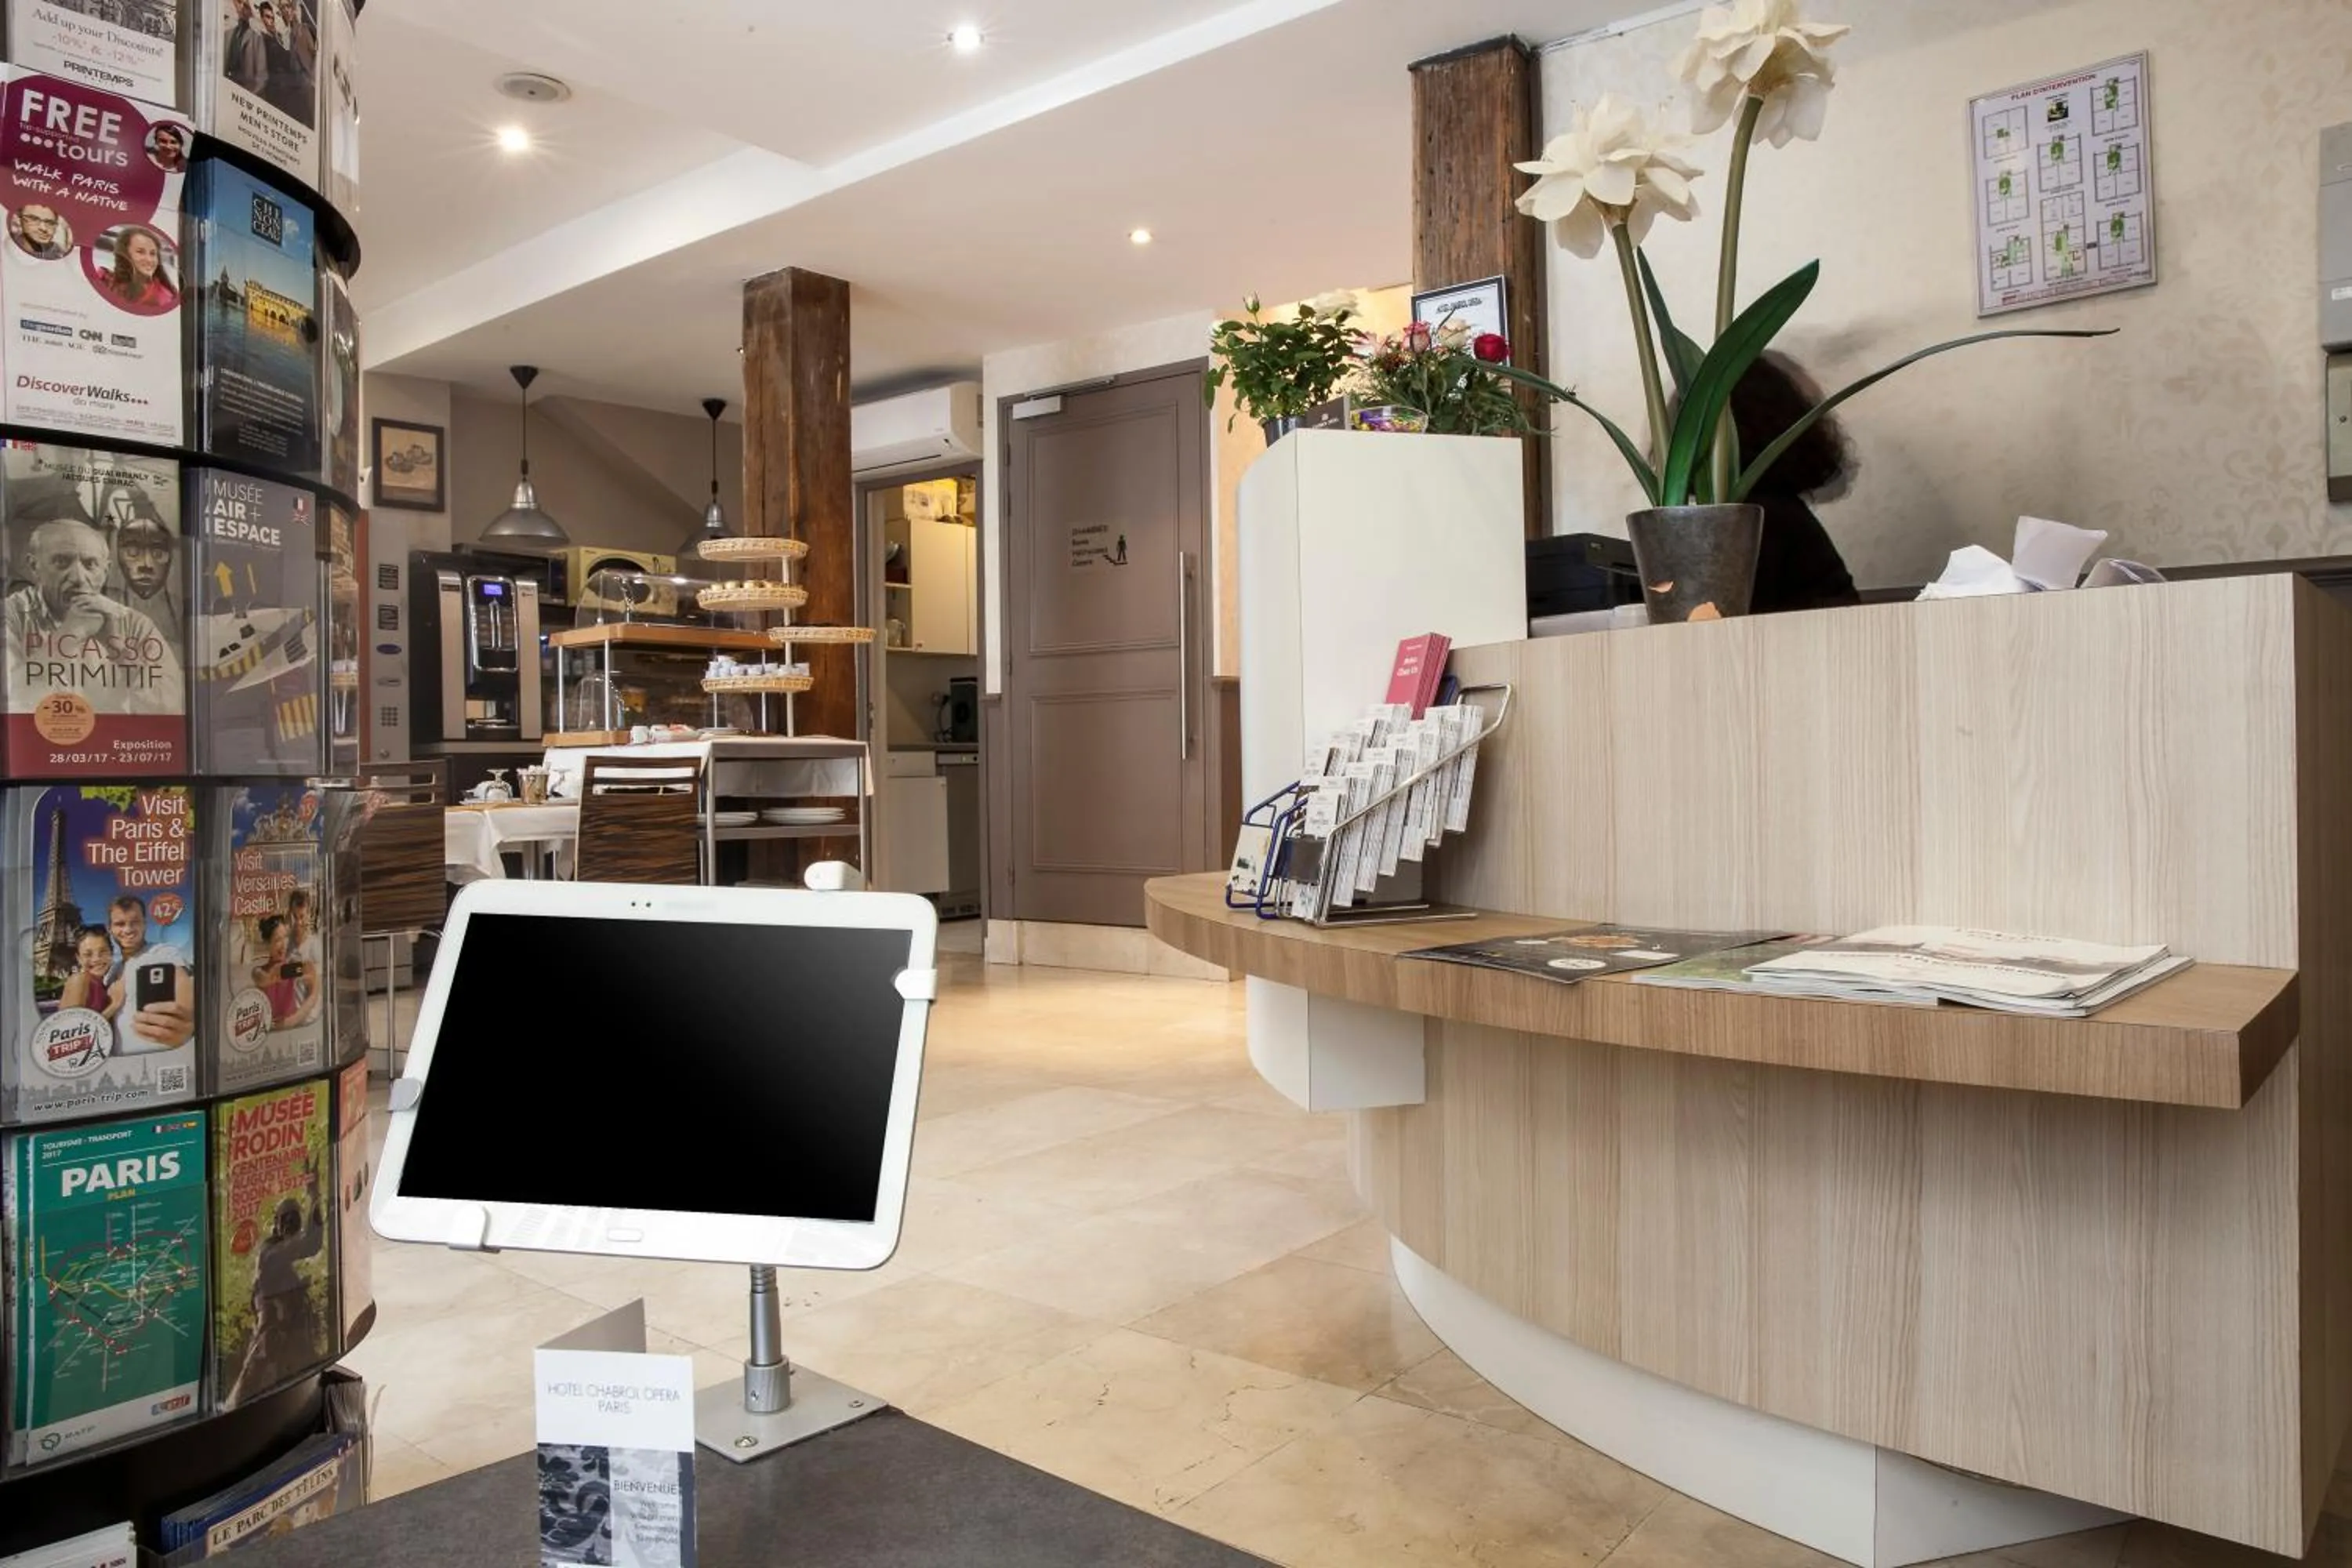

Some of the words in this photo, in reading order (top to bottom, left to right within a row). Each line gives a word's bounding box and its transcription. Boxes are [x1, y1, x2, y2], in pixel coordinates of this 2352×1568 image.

[32, 9, 58, 25] Add
[60, 20, 76, 33] up
[78, 24, 103, 38] your
[64, 60, 134, 88] PRINTEMPS
[2010, 91, 2031, 100] PLAN
[21, 89, 122, 146] FREE
[231, 93, 254, 110] NEW
[256, 107, 307, 143] PRINTEMPS
[240, 111, 269, 134] MEN'S
[270, 129, 299, 152] STORE
[13, 158, 64, 180] WALK
[71, 172, 120, 194] PARIS
[12, 174, 53, 194] WITH
[56, 187, 70, 198] A
[74, 191, 129, 212] NATIVE
[79, 328, 103, 343] CNN
[213, 479, 264, 505] MUSÉE
[213, 499, 246, 520] AIR
[250, 506, 261, 522] +
[214, 518, 281, 546] ESPACE
[25, 632, 163, 662] PICASSO
[26, 662, 162, 688] PRIMITIF
[113, 739, 172, 753] Exposition
[49, 753, 107, 764] 28/03/17
[119, 752, 172, 764] 23/07/17
[141, 794, 186, 815] Visit
[111, 818, 163, 840] Paris
[169, 818, 185, 838] &
[87, 843, 128, 864] The
[135, 840, 185, 862] Eiffel
[235, 852, 263, 871] Visit
[119, 866, 184, 887] Tower
[237, 1002, 260, 1019] Paris
[49, 1022, 91, 1043] Paris
[237, 1091, 316, 1133] MUSÉE
[88, 1130, 132, 1142] TRANSPORT
[234, 1121, 304, 1160] RODIN
[62, 1151, 180, 1197] PARIS
[233, 1184, 271, 1205] RODIN
[548, 1382, 583, 1396] HOTEL
[586, 1384, 641, 1400] CHABROL
[644, 1387, 680, 1402] OPERA
[598, 1399, 632, 1414] PARIS
[614, 1479, 678, 1495] BIENVENUE
[212, 1527, 230, 1545] LE
[236, 1508, 267, 1534] PARC
[270, 1490, 292, 1512] DES
